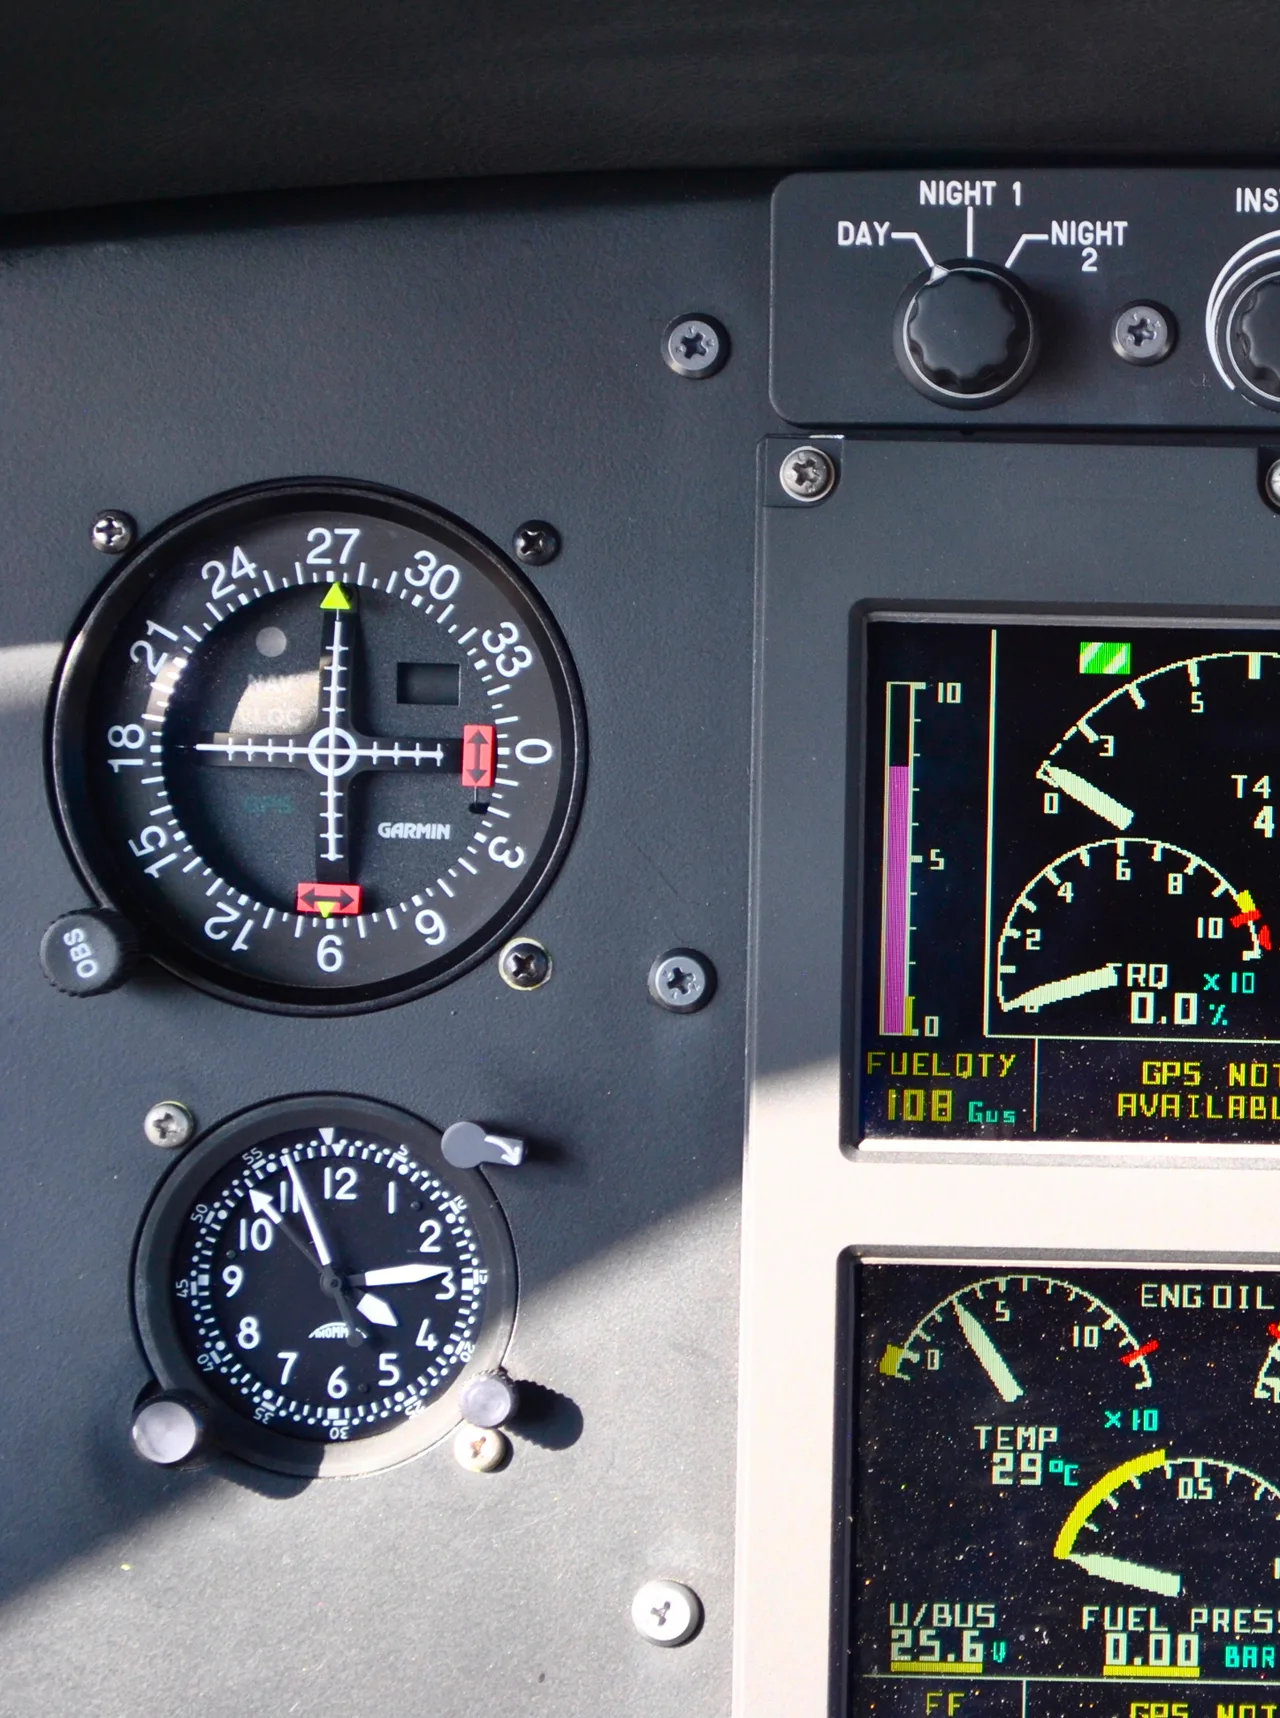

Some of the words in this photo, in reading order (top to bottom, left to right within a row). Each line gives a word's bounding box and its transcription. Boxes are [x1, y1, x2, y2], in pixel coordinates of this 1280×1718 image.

[919, 180, 997, 206] NIGHT
[1012, 181, 1022, 206] 1
[837, 221, 890, 246] DAY
[1051, 220, 1128, 246] NIGHT
[1081, 247, 1098, 272] 2
[306, 527, 361, 566] 27
[201, 546, 257, 599] 24
[404, 550, 460, 602] 30
[130, 619, 179, 675] 21
[481, 621, 532, 677] 33
[938, 683, 960, 703] 10
[1191, 693, 1204, 714] 5
[107, 723, 145, 773] 18
[515, 738, 553, 765] 0
[1099, 736, 1114, 757] 3
[1231, 774, 1271, 799] T4
[1044, 793, 1058, 814] 0
[377, 821, 451, 841] GARMIN
[128, 825, 169, 879] 15
[488, 836, 526, 869] 3
[930, 850, 944, 870] 5
[1116, 859, 1131, 880] 6
[1057, 881, 1073, 902] 4
[1168, 873, 1183, 894] 8
[204, 905, 253, 952] 12
[1025, 929, 1041, 950] 2
[1197, 917, 1224, 939] 10
[63, 927, 99, 979] OBS
[1130, 992, 1198, 1025] 0.0
[867, 1052, 1016, 1079] FUELQTY
[1143, 1061, 1201, 1086] GPS
[888, 1089, 952, 1122] 108
[241, 1147, 264, 1166] 55
[323, 1167, 358, 1200] 12
[387, 1181, 395, 1214] 1
[190, 1203, 208, 1224] 50
[240, 1219, 273, 1251] 10
[419, 1219, 441, 1252] 2
[175, 1279, 189, 1298] 45
[222, 1265, 243, 1298] 9
[435, 1268, 456, 1300] 3
[996, 1301, 1010, 1322] 5
[237, 1317, 261, 1349] 8
[415, 1318, 438, 1352] 4
[1072, 1325, 1099, 1347] 10
[197, 1353, 214, 1372] 40
[277, 1352, 298, 1385] 7
[378, 1353, 400, 1386] 5
[926, 1350, 940, 1371] 0
[327, 1366, 348, 1399] 6
[253, 1407, 274, 1424] 35
[329, 1426, 349, 1439] 30
[974, 1425, 1058, 1451] TEMP
[1178, 1477, 1213, 1500] 0.5
[889, 1603, 995, 1628] U/BUS
[1082, 1606, 1158, 1632] FUEL
[1104, 1633, 1200, 1668] 0.00
[1225, 1646, 1275, 1668] BAR
[925, 1692, 966, 1717] FF
[1130, 1702, 1188, 1718] GPS
[1217, 1704, 1278, 1718] NOT
